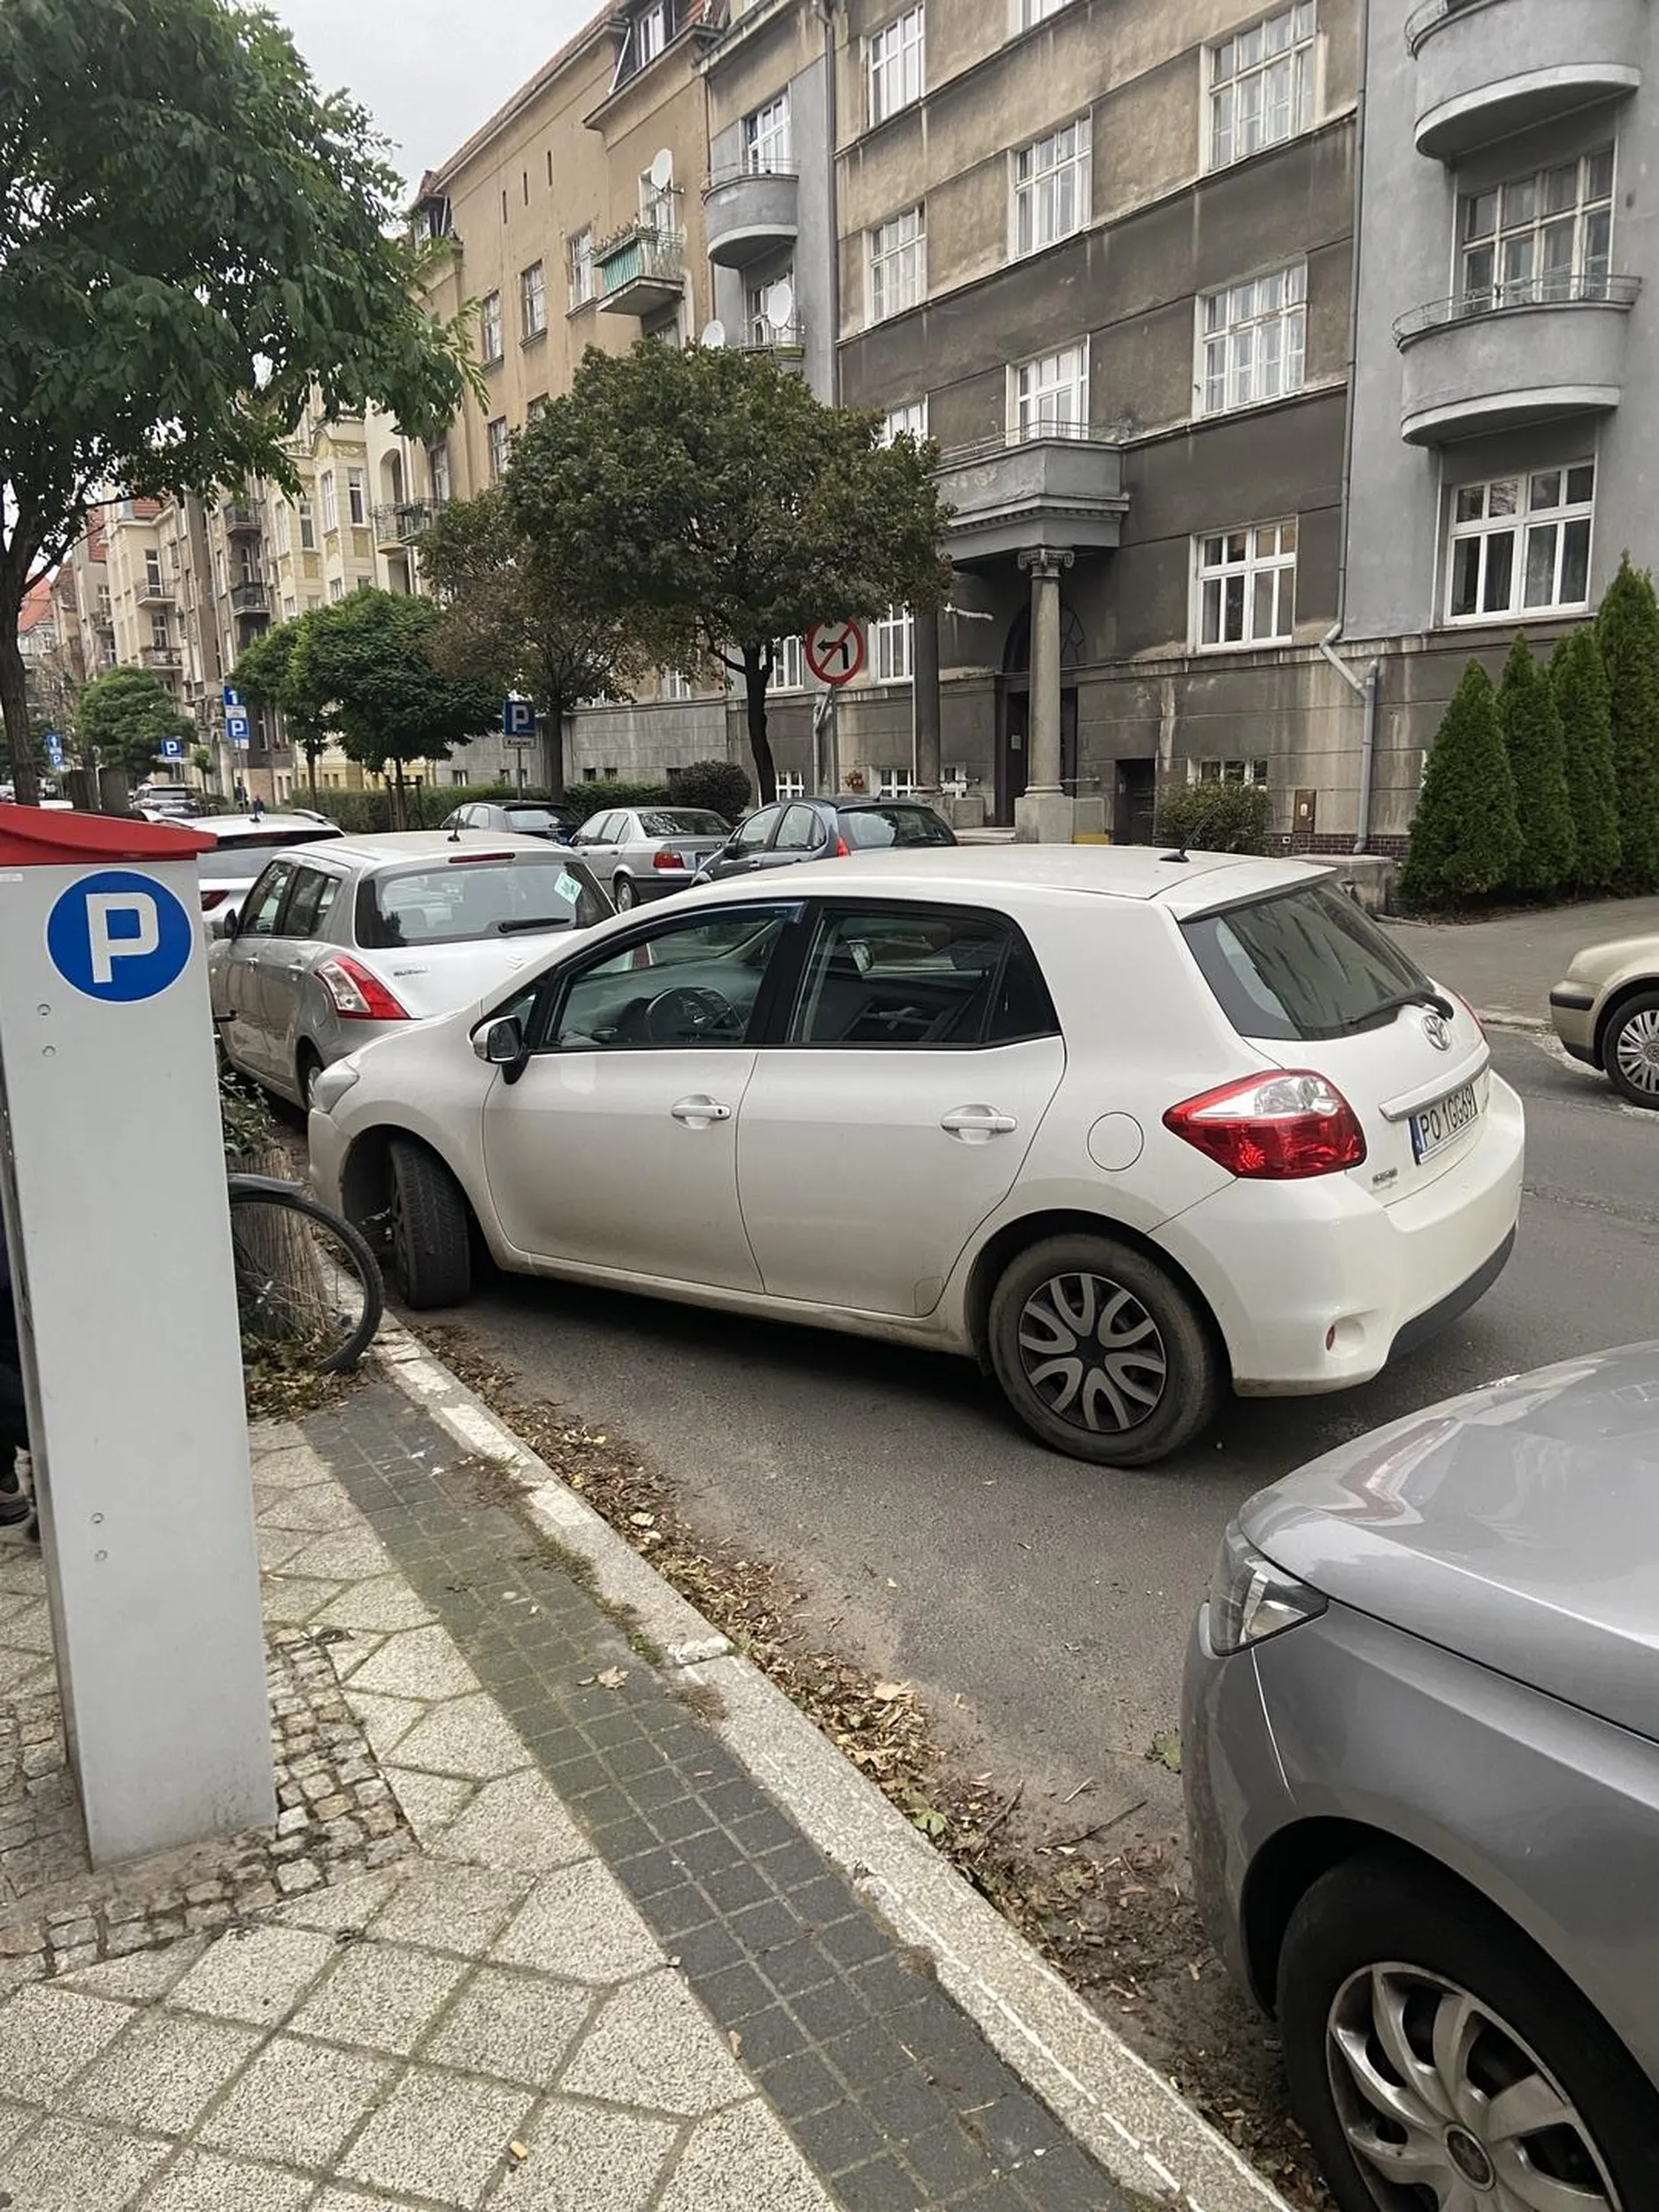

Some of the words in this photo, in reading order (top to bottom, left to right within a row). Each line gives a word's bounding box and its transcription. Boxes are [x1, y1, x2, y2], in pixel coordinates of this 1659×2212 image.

[231, 719, 244, 737] P
[511, 704, 529, 732] P
[165, 741, 178, 756] P
[86, 892, 160, 983] P
[1420, 1109, 1440, 1148] PO
